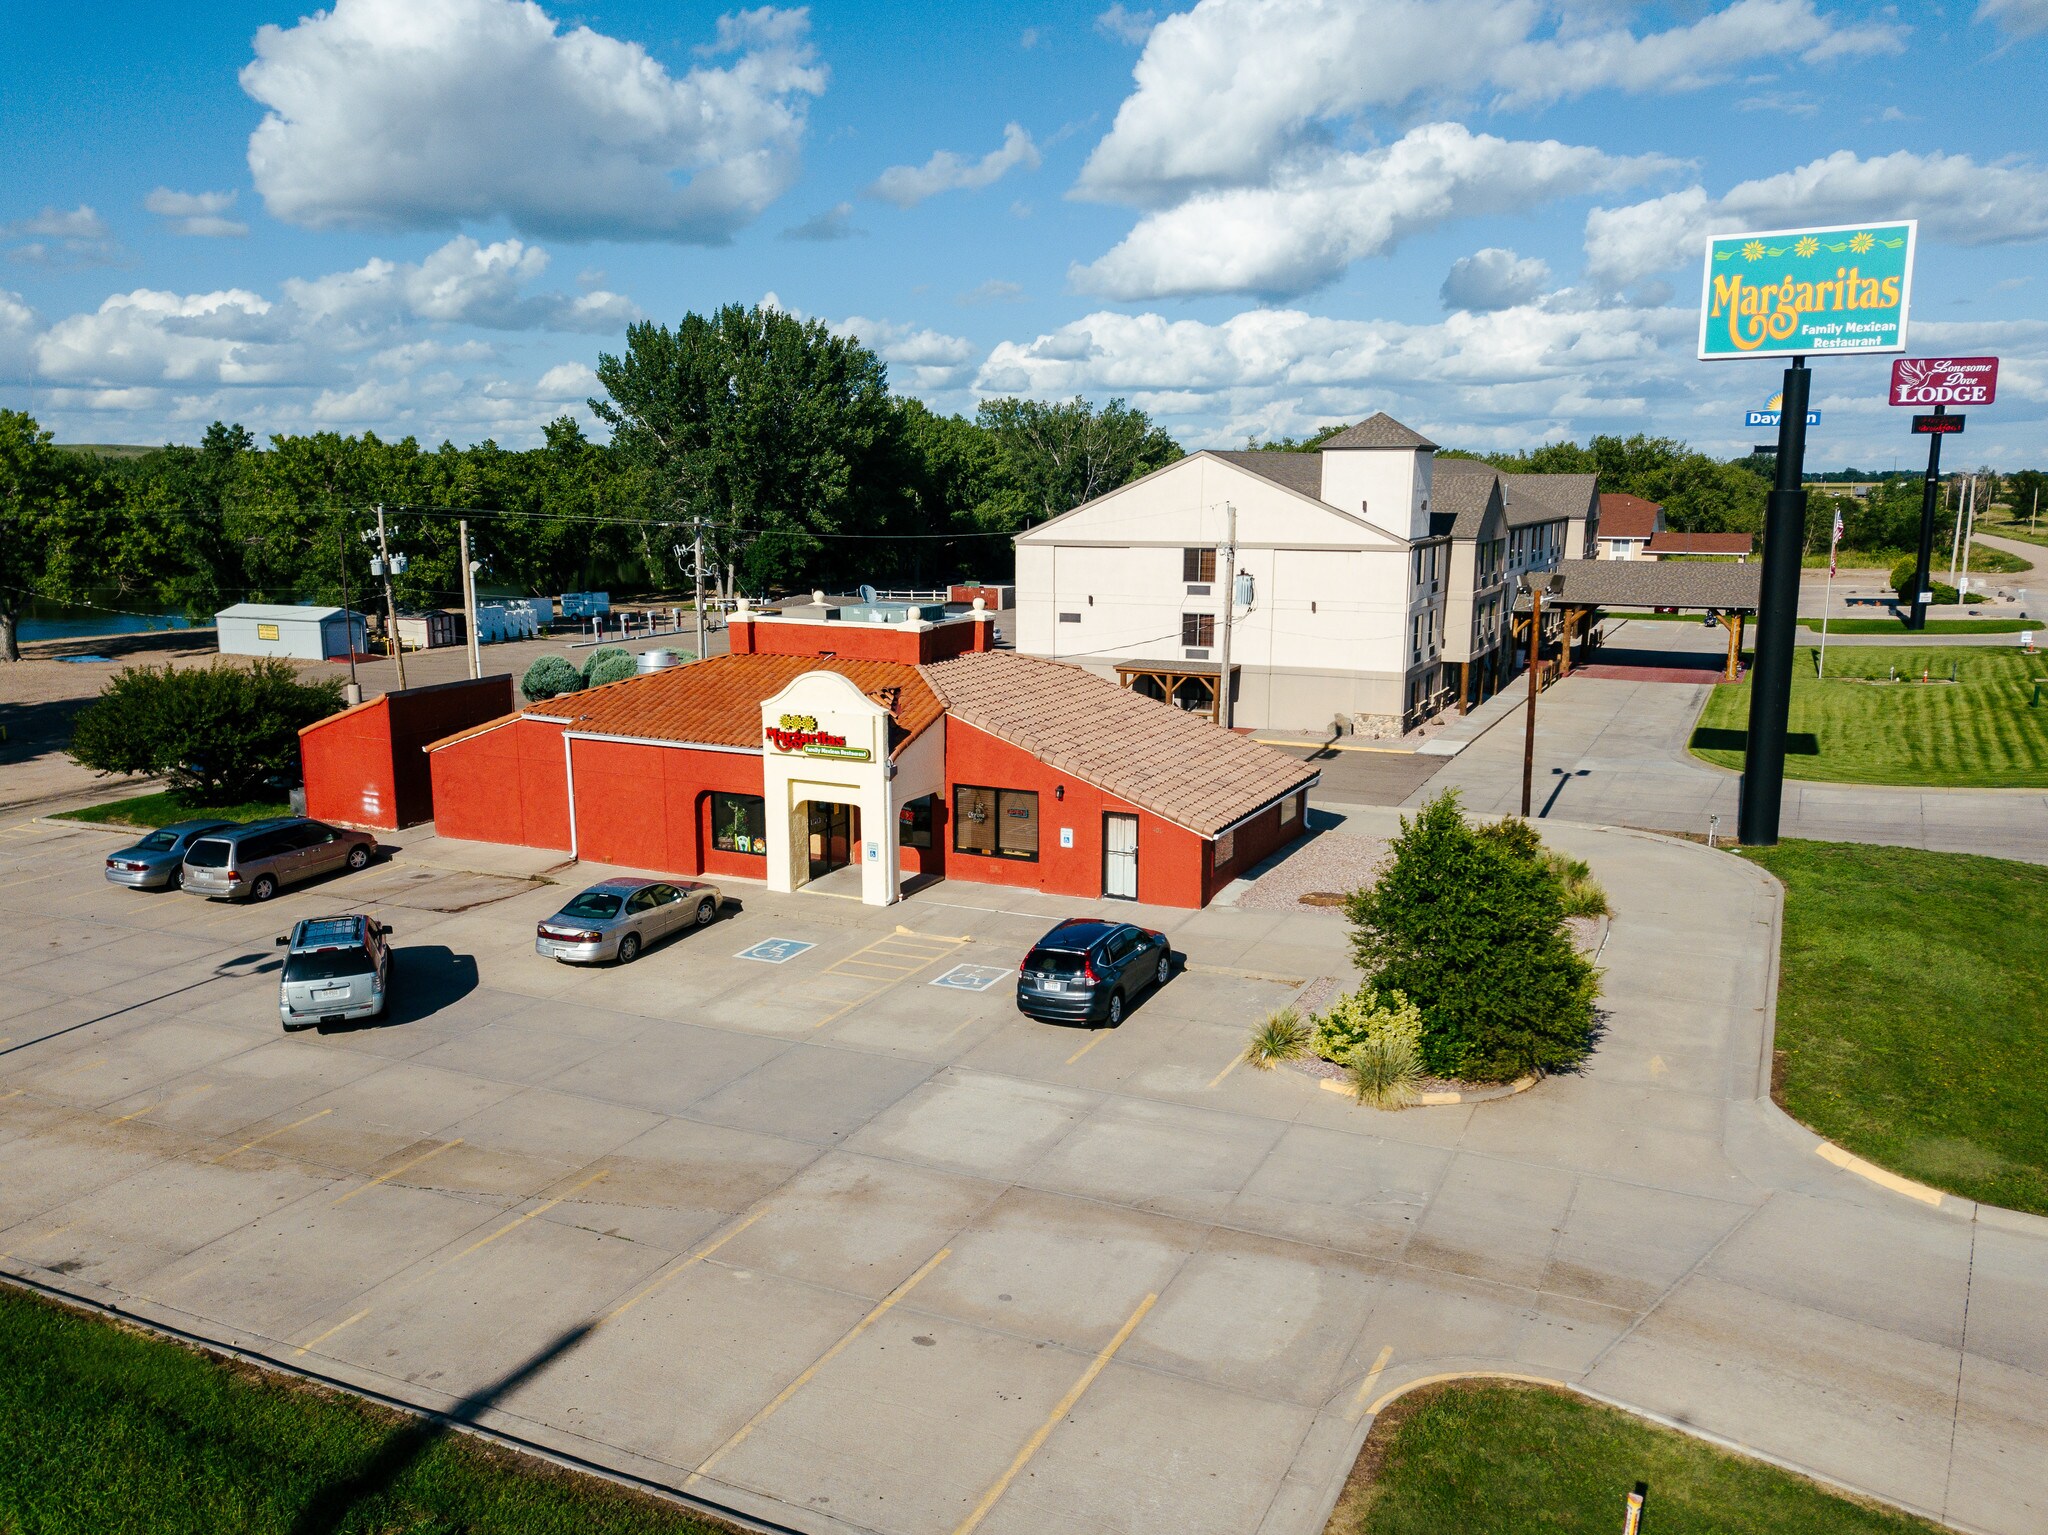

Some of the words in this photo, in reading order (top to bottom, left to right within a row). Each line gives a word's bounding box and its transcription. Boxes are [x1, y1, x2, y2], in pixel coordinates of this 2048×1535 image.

[1710, 266, 1900, 350] Margaritas
[1801, 324, 1842, 336] Family
[1845, 321, 1897, 333] Mexican
[1813, 335, 1882, 348] Restaurant
[1933, 361, 1992, 373] Lonesome
[1943, 373, 1978, 386] Dove
[1898, 384, 1987, 402] LODGE
[1749, 413, 1781, 426] Day
[765, 727, 846, 752] Margaritas
